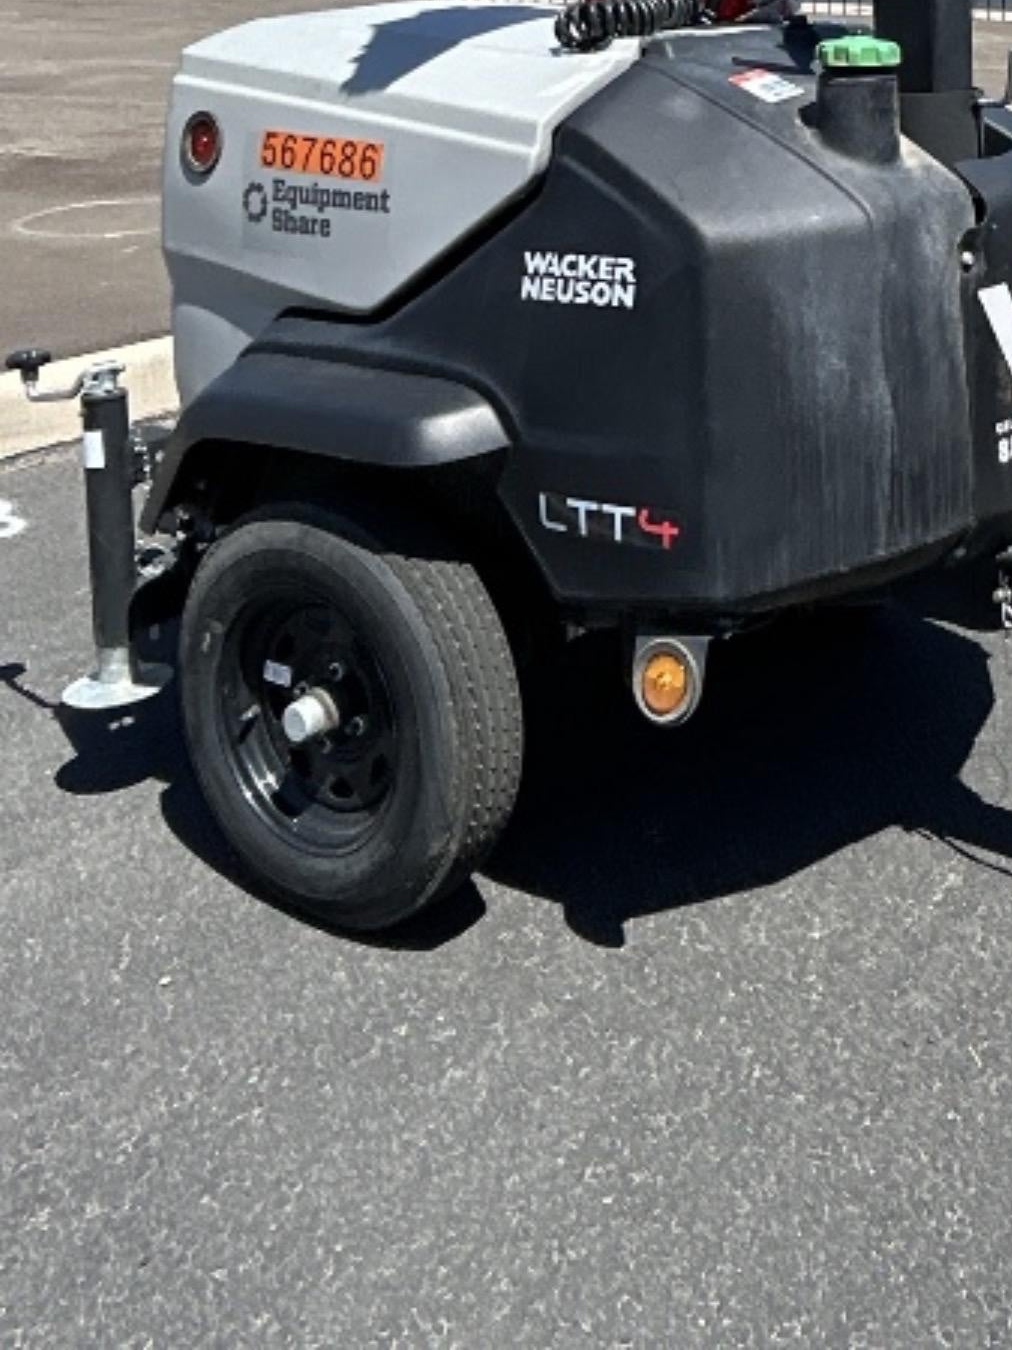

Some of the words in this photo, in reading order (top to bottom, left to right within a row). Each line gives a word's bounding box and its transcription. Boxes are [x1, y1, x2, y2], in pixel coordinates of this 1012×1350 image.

[262, 132, 378, 179] 567686
[271, 178, 391, 213] Equipment
[271, 207, 331, 238] Share
[523, 251, 636, 282] WACKER
[521, 275, 637, 309] NEUSON
[538, 492, 680, 549] LTT4
